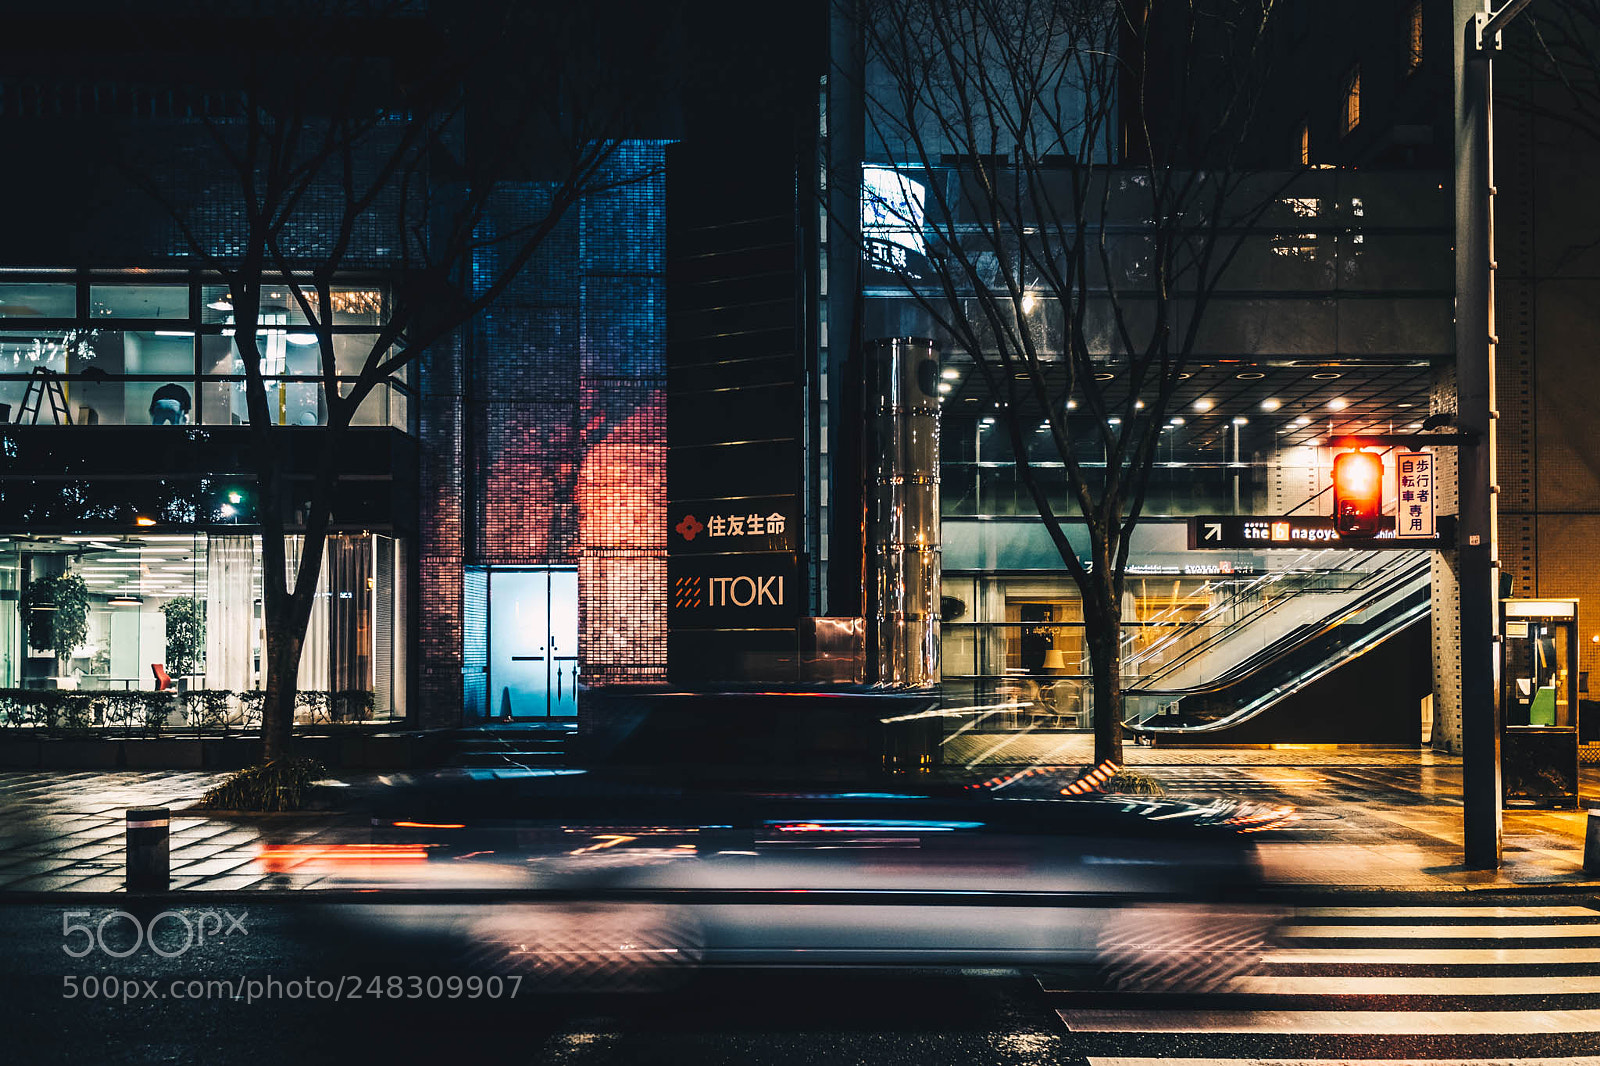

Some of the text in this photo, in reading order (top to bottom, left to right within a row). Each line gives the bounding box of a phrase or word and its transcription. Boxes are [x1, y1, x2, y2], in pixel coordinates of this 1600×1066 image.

[1402, 460, 1415, 502] 自転車
[1416, 460, 1429, 502] 歩行者
[707, 512, 786, 537] 住友生命
[1244, 522, 1340, 541] the b nagoya
[1409, 504, 1423, 531] 専用
[709, 575, 784, 607] ITOKI
